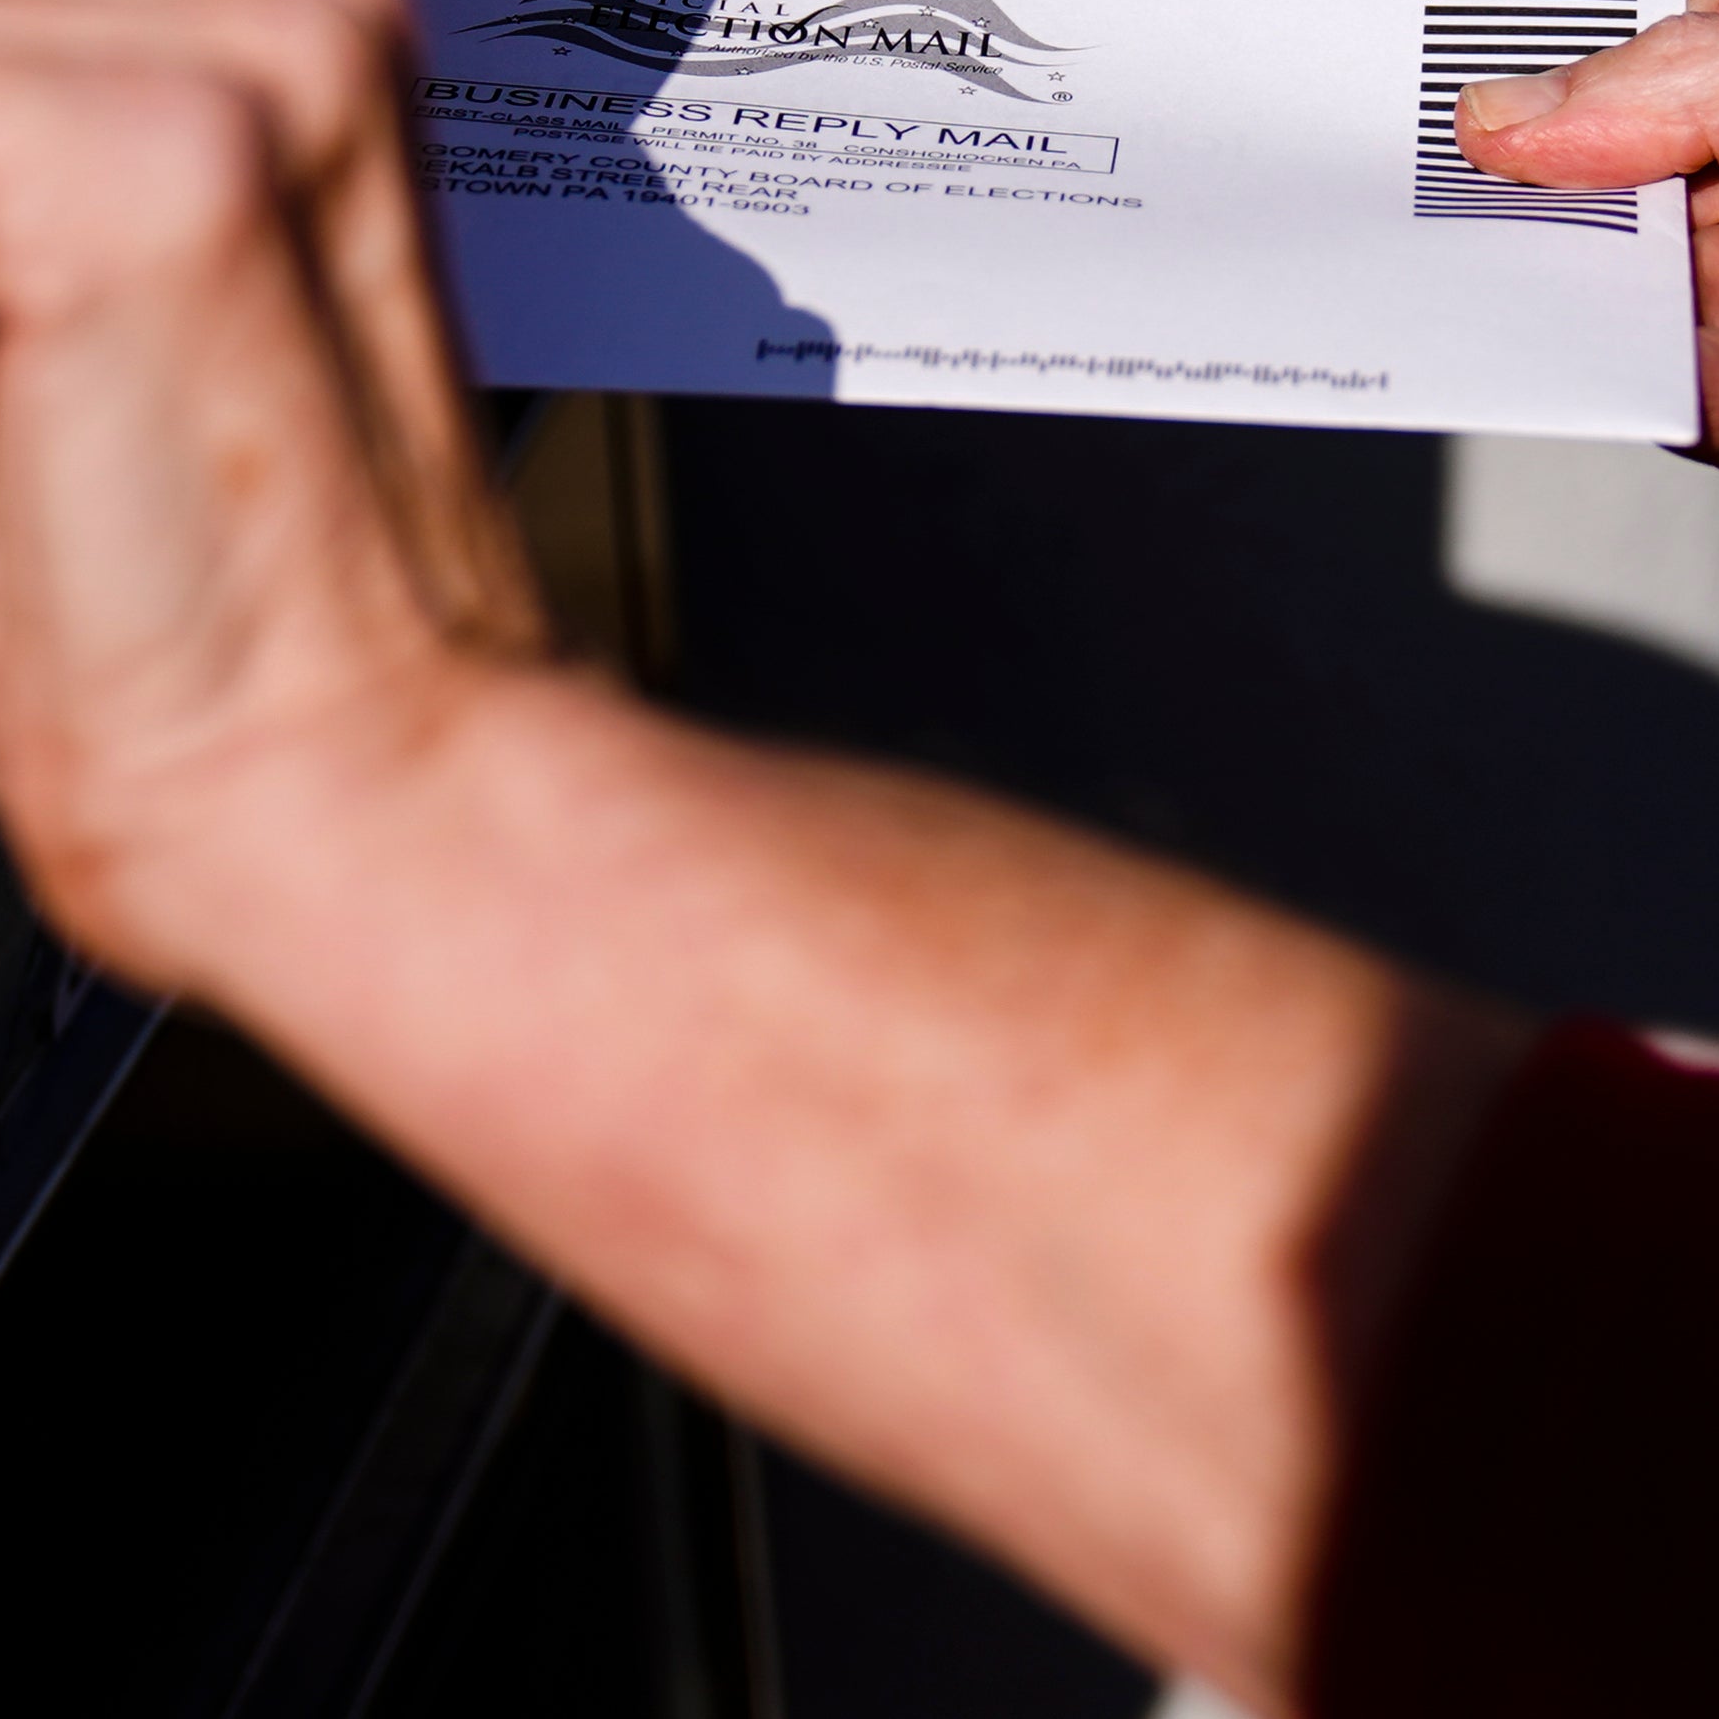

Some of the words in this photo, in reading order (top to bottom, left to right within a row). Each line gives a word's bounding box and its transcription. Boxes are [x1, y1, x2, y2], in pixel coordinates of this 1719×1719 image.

[587, 3, 853, 51] ELECTION
[869, 27, 1003, 58] MAIL
[707, 42, 794, 60] Authorized
[797, 50, 821, 62] by
[822, 52, 848, 64] the
[852, 55, 884, 67] U.S.
[891, 57, 941, 71] Postal
[942, 61, 1004, 76] Service
[414, 106, 566, 127] FIRST-CLASS
[572, 118, 626, 131] MAIL
[651, 126, 740, 142] PERMIT
[745, 135, 783, 147] NO.
[792, 139, 818, 150] 38
[843, 144, 1044, 167] CONSHOHOCKEN
[1050, 160, 1082, 170] PA
[423, 82, 713, 122] BUSINESS
[733, 108, 921, 141] REPLY
[937, 127, 1068, 155] MAIL
[512, 127, 626, 145] POSTAGE
[633, 136, 685, 151] WILL
[693, 143, 723, 154] BE
[731, 147, 784, 159] PAID
[791, 152, 823, 162] BY
[828, 156, 972, 173] ADDRESSEE
[419, 159, 540, 178] EKALB
[550, 167, 686, 190] STREET
[701, 182, 799, 200] REAR
[419, 175, 553, 198] STOWN
[561, 183, 610, 200] PA
[623, 189, 810, 216] 19401-9903
[421, 143, 580, 165] GOMERY
[589, 155, 738, 179] COUNTY
[749, 171, 874, 192] BOARD
[885, 181, 933, 194] OF
[944, 184, 1143, 209] ELECTIONS
